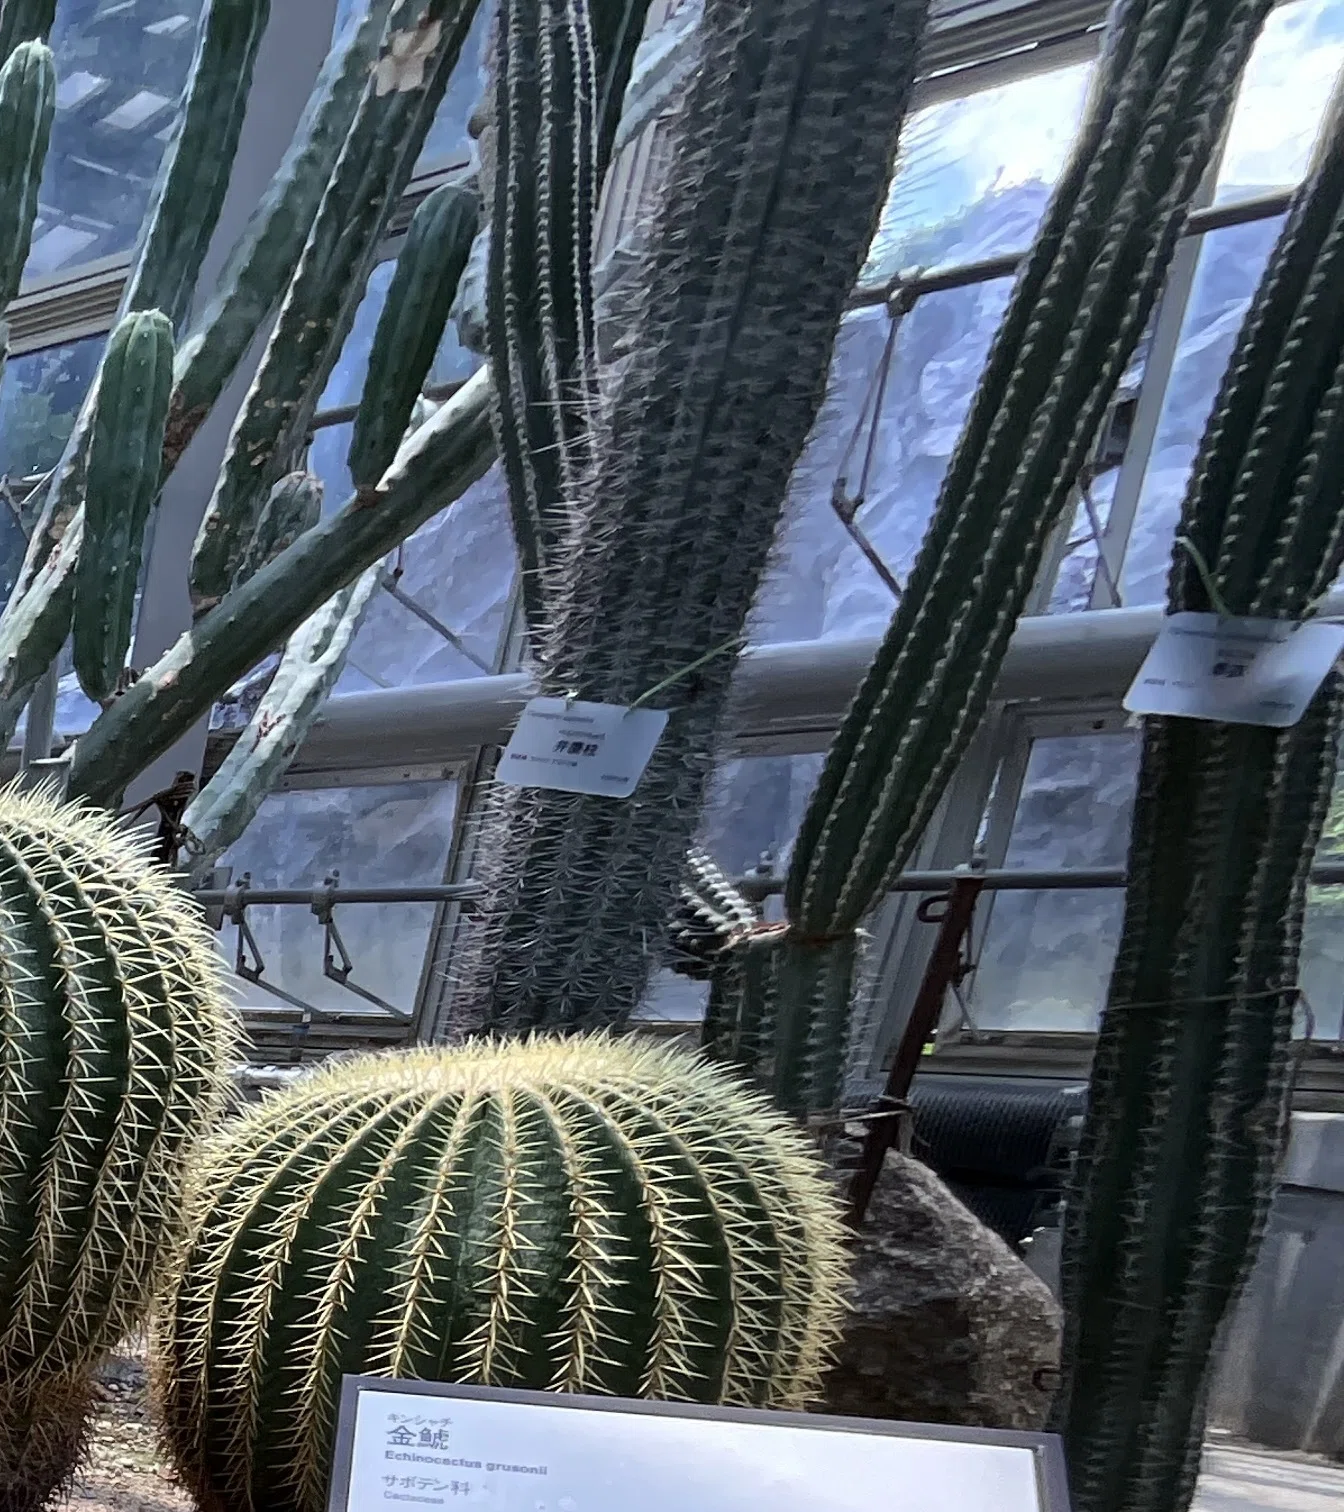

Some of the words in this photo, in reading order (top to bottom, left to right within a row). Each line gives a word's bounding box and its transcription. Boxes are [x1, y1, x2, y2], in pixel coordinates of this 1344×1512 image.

[387, 1413, 453, 1427] キンシャチ
[386, 1425, 450, 1450] 金鯱
[385, 1450, 482, 1468] Echinocactus
[486, 1462, 548, 1476] grusonii
[381, 1474, 470, 1496] サボテン科
